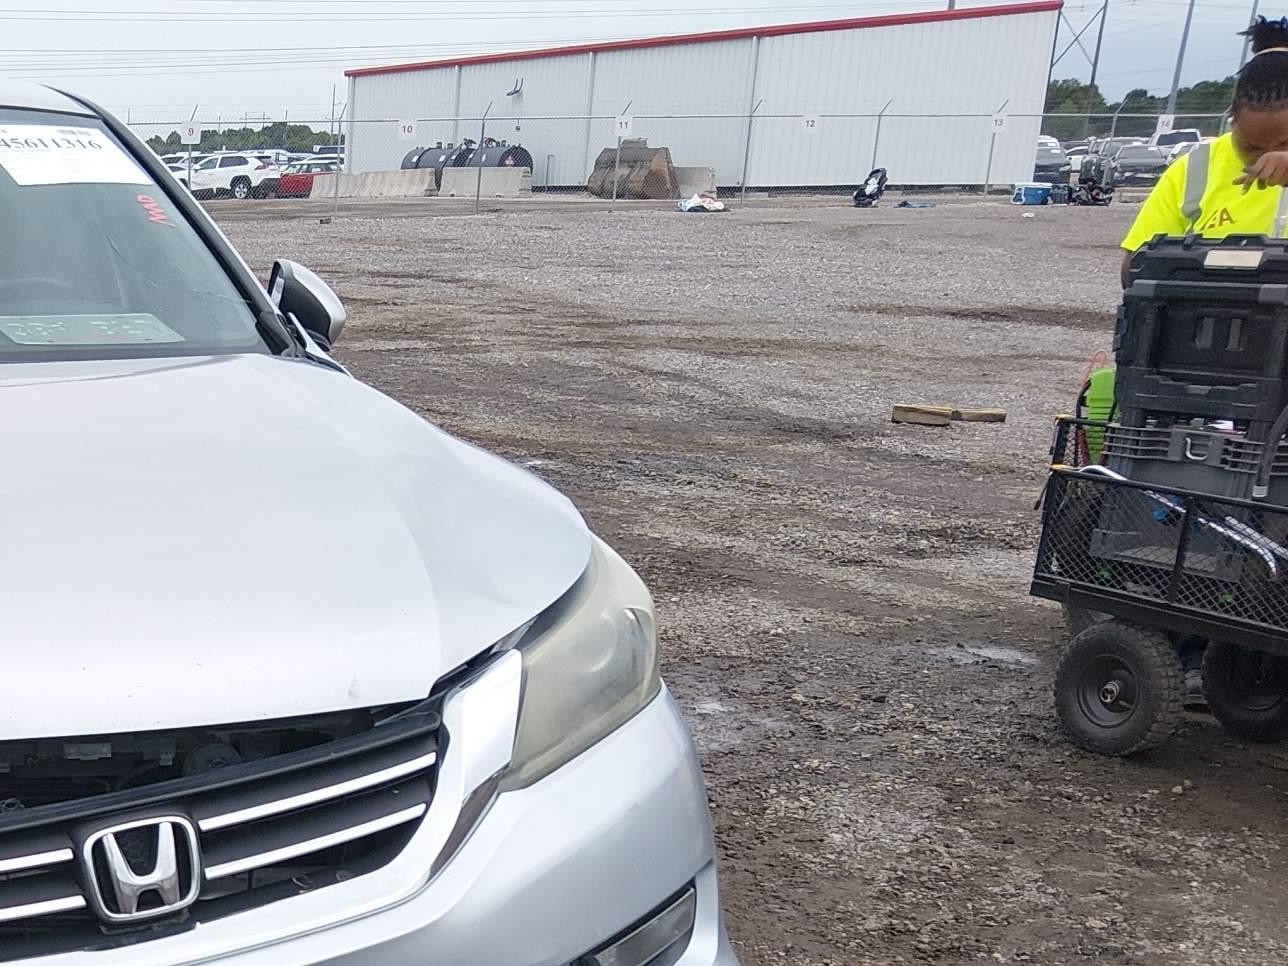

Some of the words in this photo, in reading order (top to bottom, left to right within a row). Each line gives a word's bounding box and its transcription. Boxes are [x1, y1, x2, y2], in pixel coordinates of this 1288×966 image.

[618, 120, 628, 130] 11
[805, 119, 816, 128] 12
[994, 118, 1004, 127] 13
[187, 127, 195, 137] 9
[401, 124, 414, 134] 10
